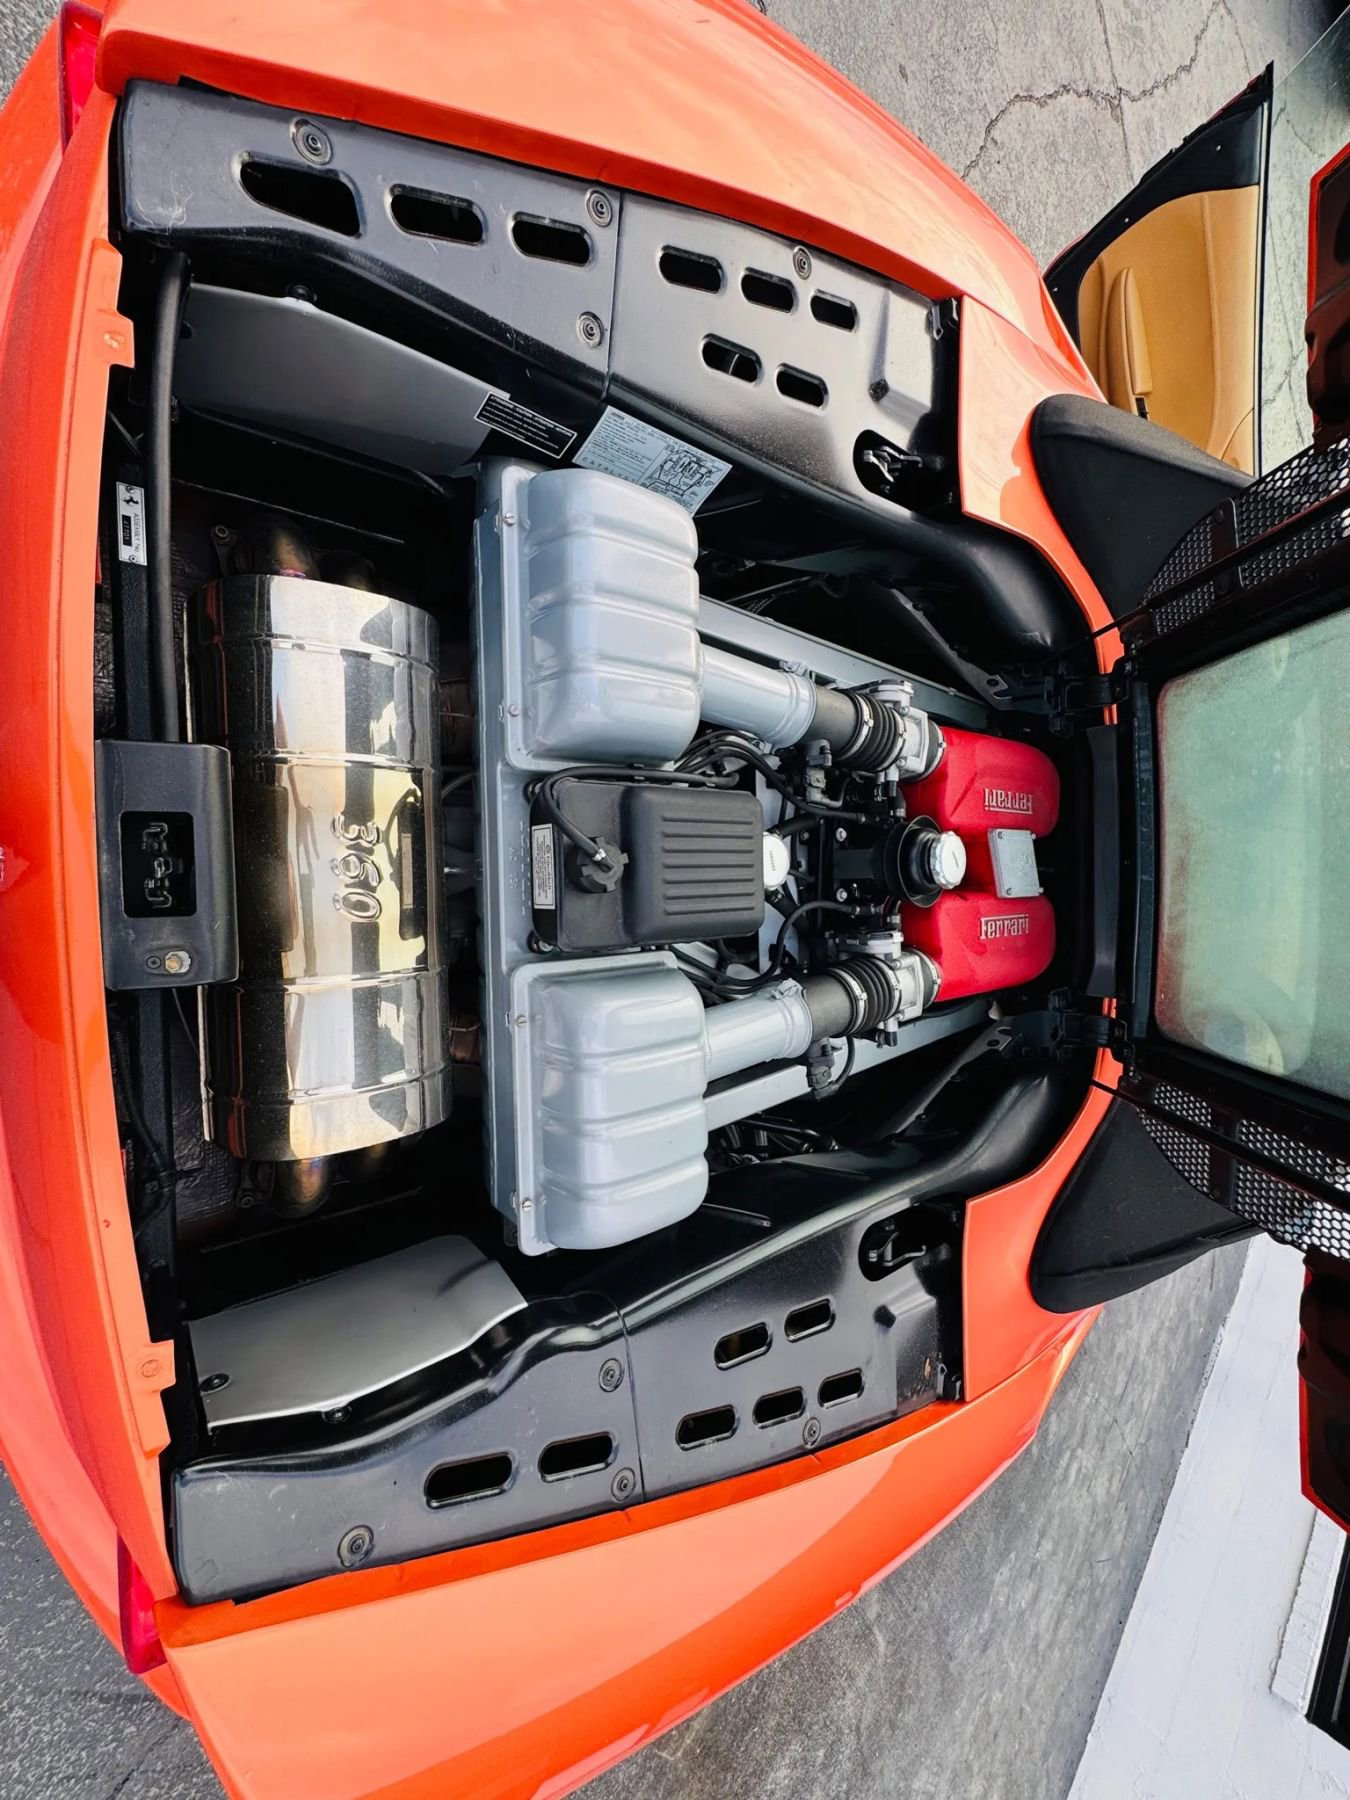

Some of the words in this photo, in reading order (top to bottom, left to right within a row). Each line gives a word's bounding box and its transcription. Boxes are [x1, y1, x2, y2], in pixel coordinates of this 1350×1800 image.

[983, 788, 1033, 815] Ferrari
[334, 815, 382, 921] 360
[979, 914, 1030, 940] Ferrari
